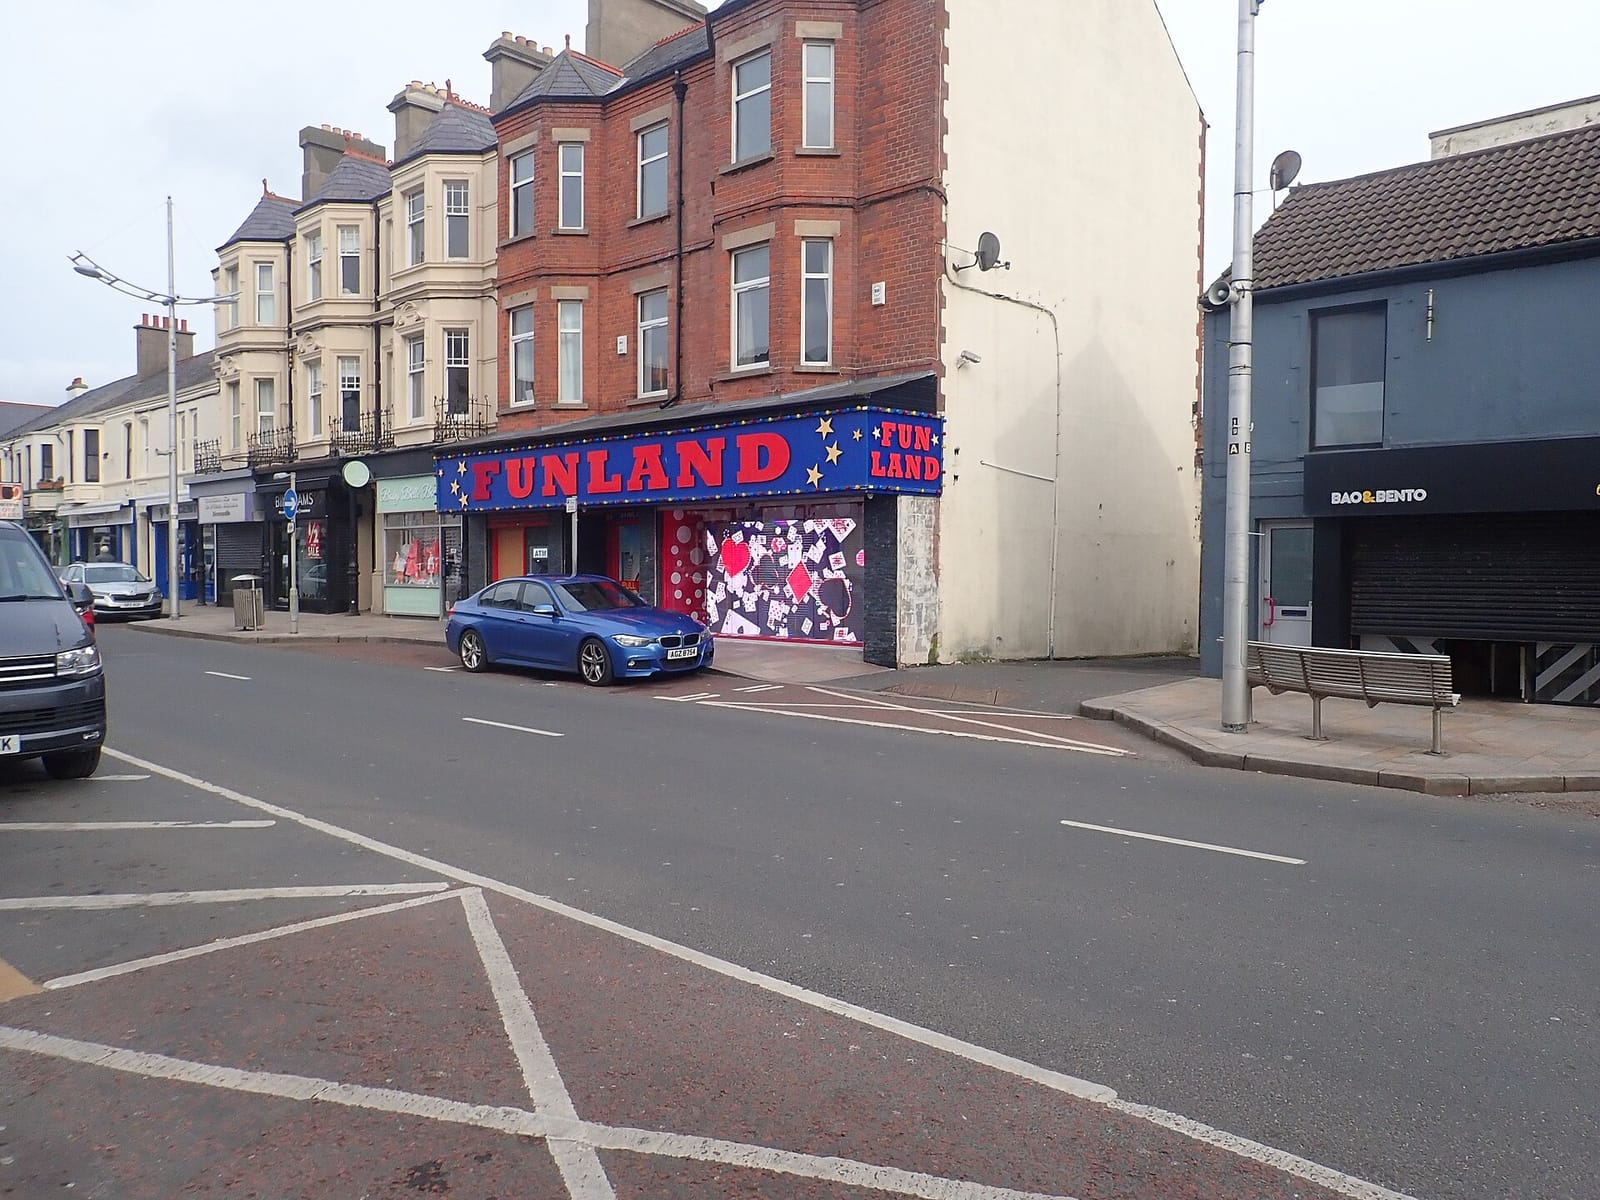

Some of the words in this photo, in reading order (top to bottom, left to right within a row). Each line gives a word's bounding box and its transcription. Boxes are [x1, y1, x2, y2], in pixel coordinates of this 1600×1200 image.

[881, 421, 931, 451] FUN
[1230, 443, 1239, 454] A
[471, 432, 791, 500] FUNLAND
[871, 451, 940, 480] LAND
[1331, 488, 1427, 504] BAO&BENTO
[535, 550, 547, 558] ATM
